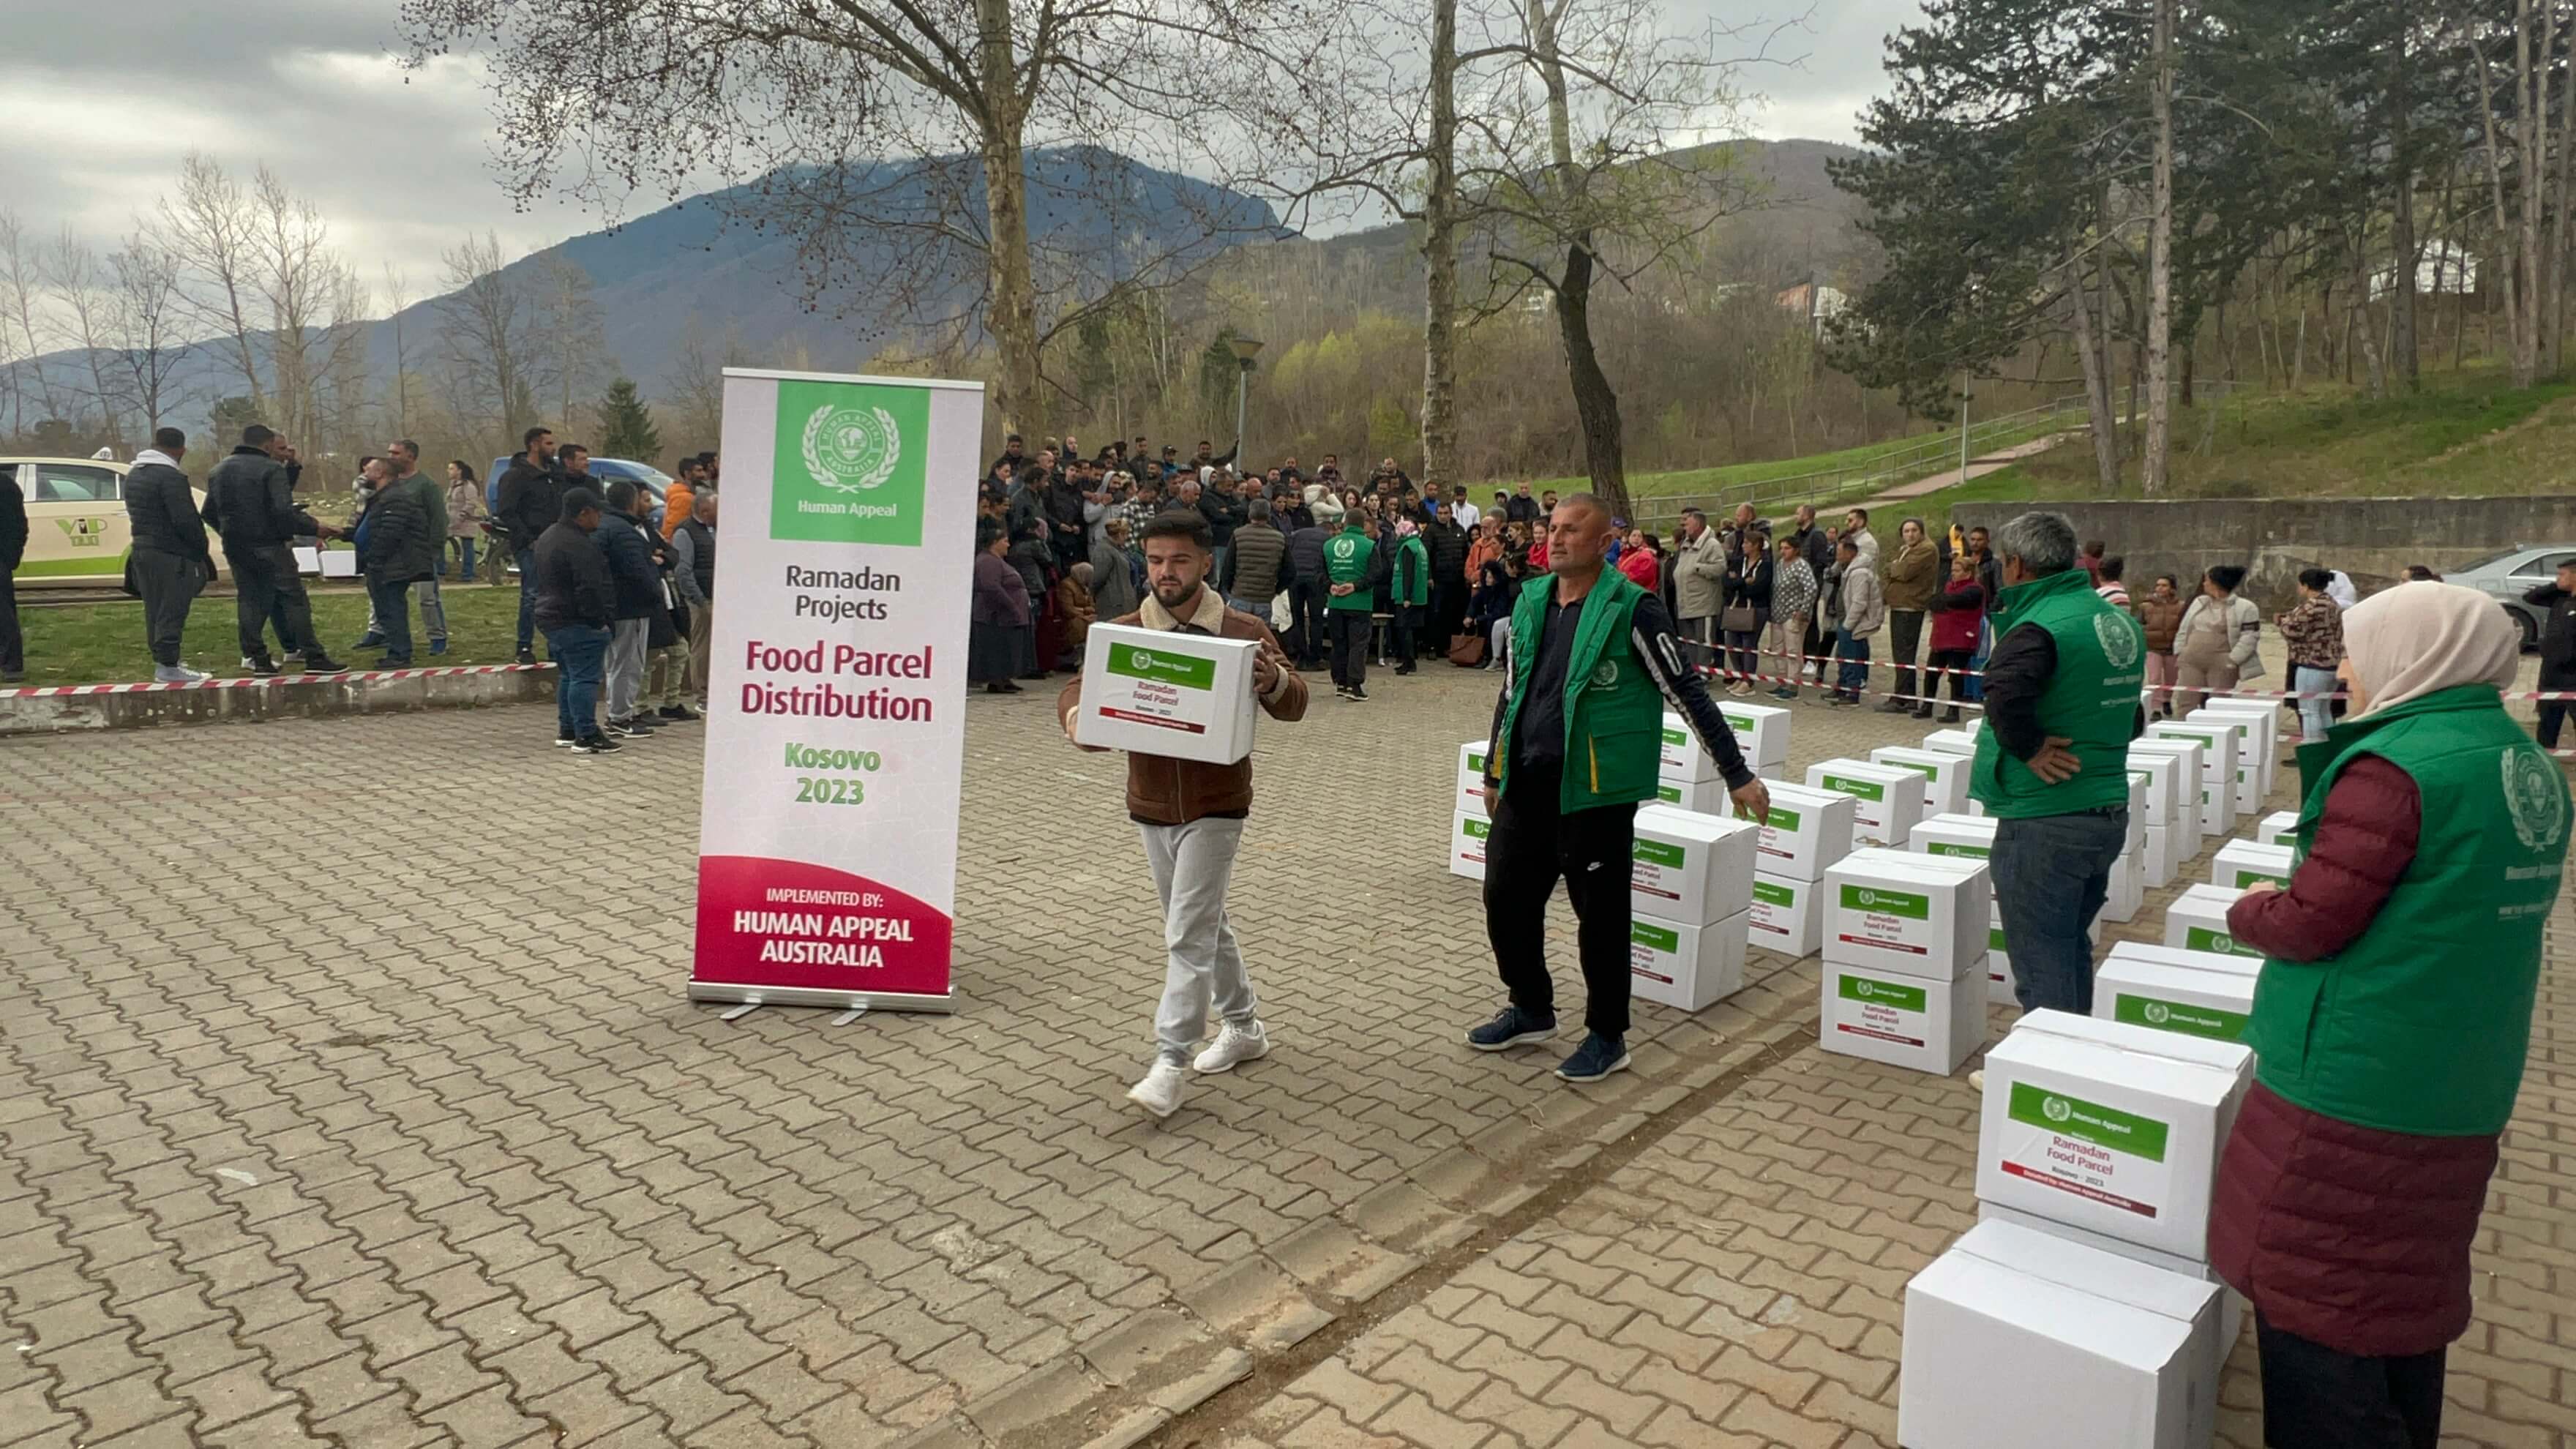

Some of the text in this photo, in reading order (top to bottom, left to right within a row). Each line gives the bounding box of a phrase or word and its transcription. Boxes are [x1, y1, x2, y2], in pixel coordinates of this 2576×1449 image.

[798, 500, 897, 518] Human Appeal
[786, 565, 901, 591] Ramadan
[795, 595, 888, 624] Projects
[746, 640, 932, 679] Food Parcel
[741, 682, 932, 722] Distribution
[785, 742, 882, 772] Kosovo
[795, 777, 865, 805] 2023
[766, 888, 884, 907] IMPLEMENTED BY:
[733, 911, 913, 942] HUMAN APPEAL
[760, 940, 884, 967] AUSTRALIA
[2047, 1147, 2114, 1176] Food Parcel
[2052, 1136, 2111, 1161] Ramadan
